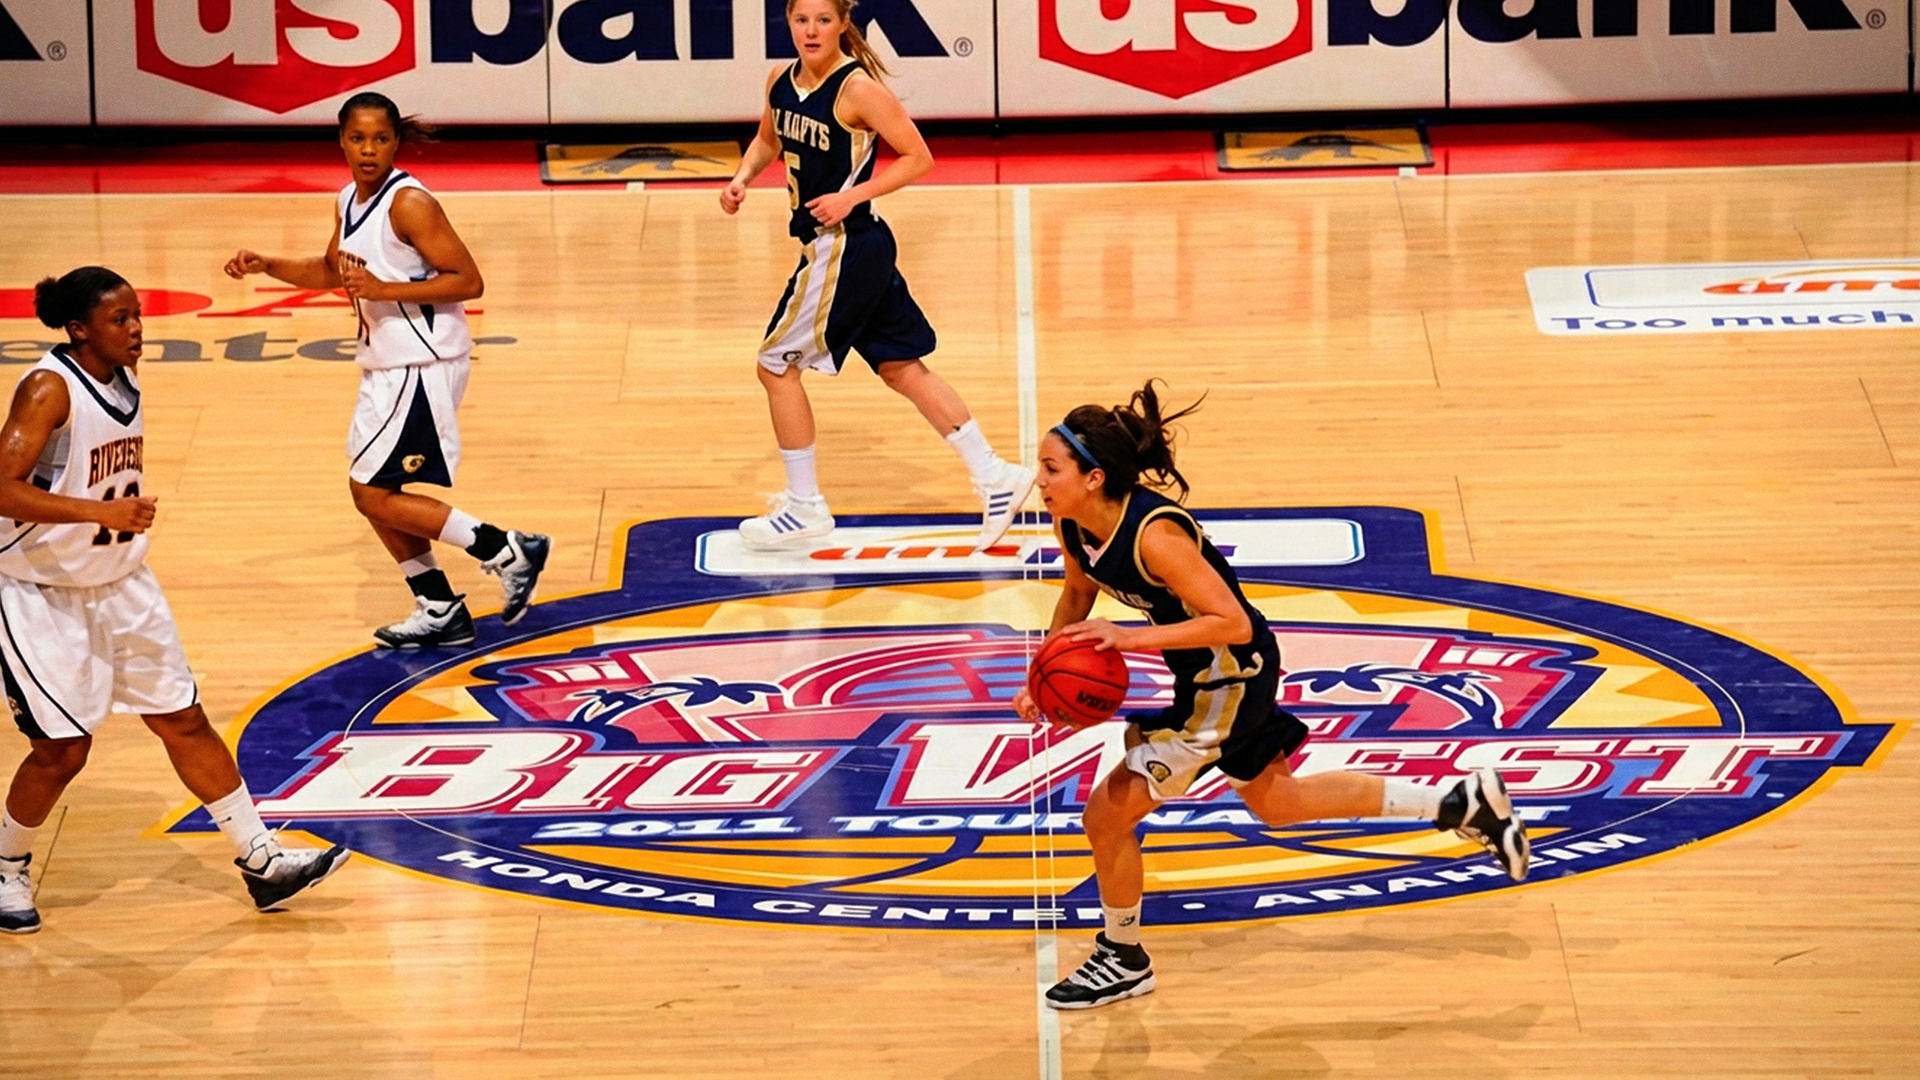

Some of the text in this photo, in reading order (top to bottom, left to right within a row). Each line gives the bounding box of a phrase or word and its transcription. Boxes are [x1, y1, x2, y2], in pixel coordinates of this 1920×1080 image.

[1551, 310, 1914, 330] Too much
[258, 721, 1846, 815] BIG WEST
[533, 815, 805, 839] 2011
[437, 849, 718, 908] HONDA
